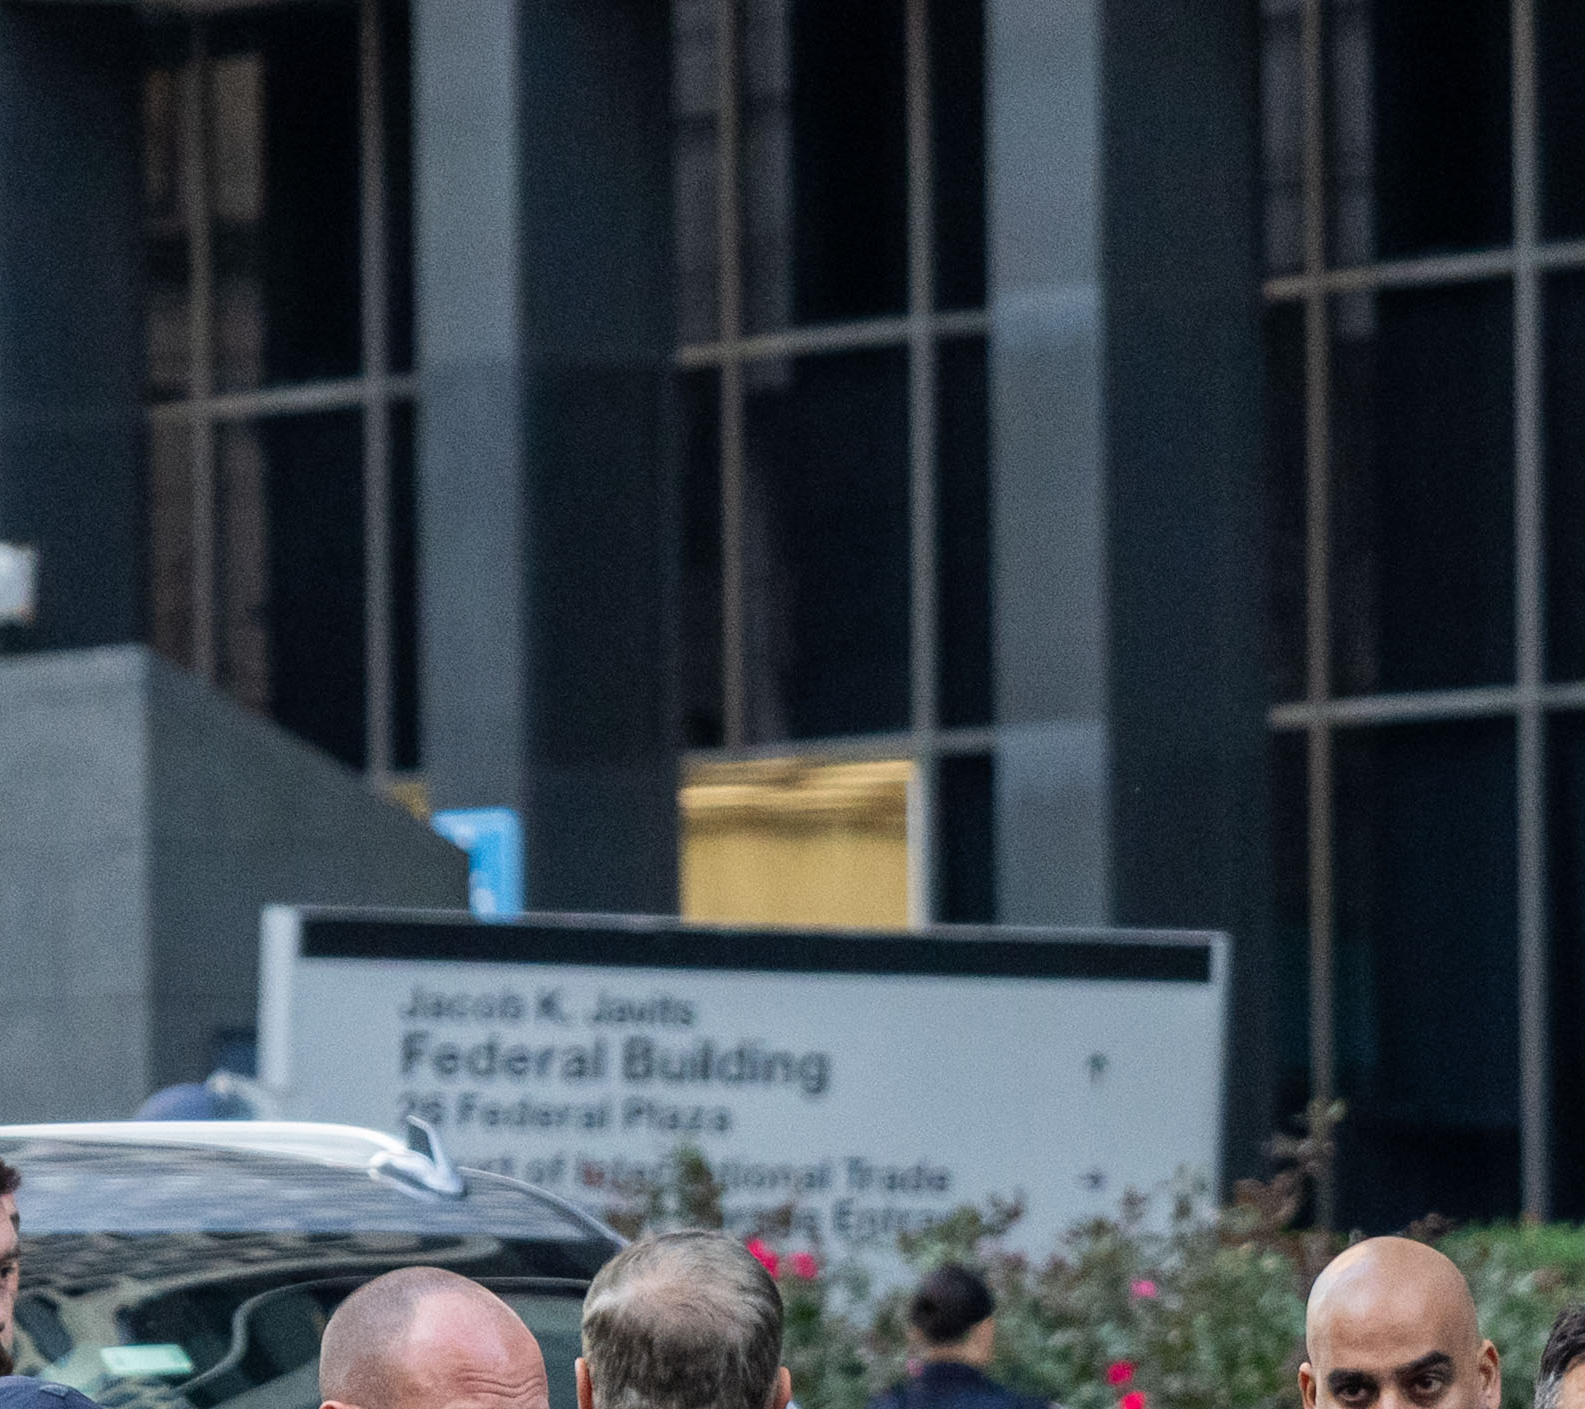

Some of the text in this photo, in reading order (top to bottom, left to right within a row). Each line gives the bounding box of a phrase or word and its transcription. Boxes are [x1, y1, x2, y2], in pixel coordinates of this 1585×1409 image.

[403, 986, 695, 1026] Jacob K. Javits
[399, 1030, 831, 1096] Federal Building
[457, 1093, 609, 1129] Federal
[622, 1098, 732, 1132] Plaza
[844, 1156, 952, 1192] Trade
